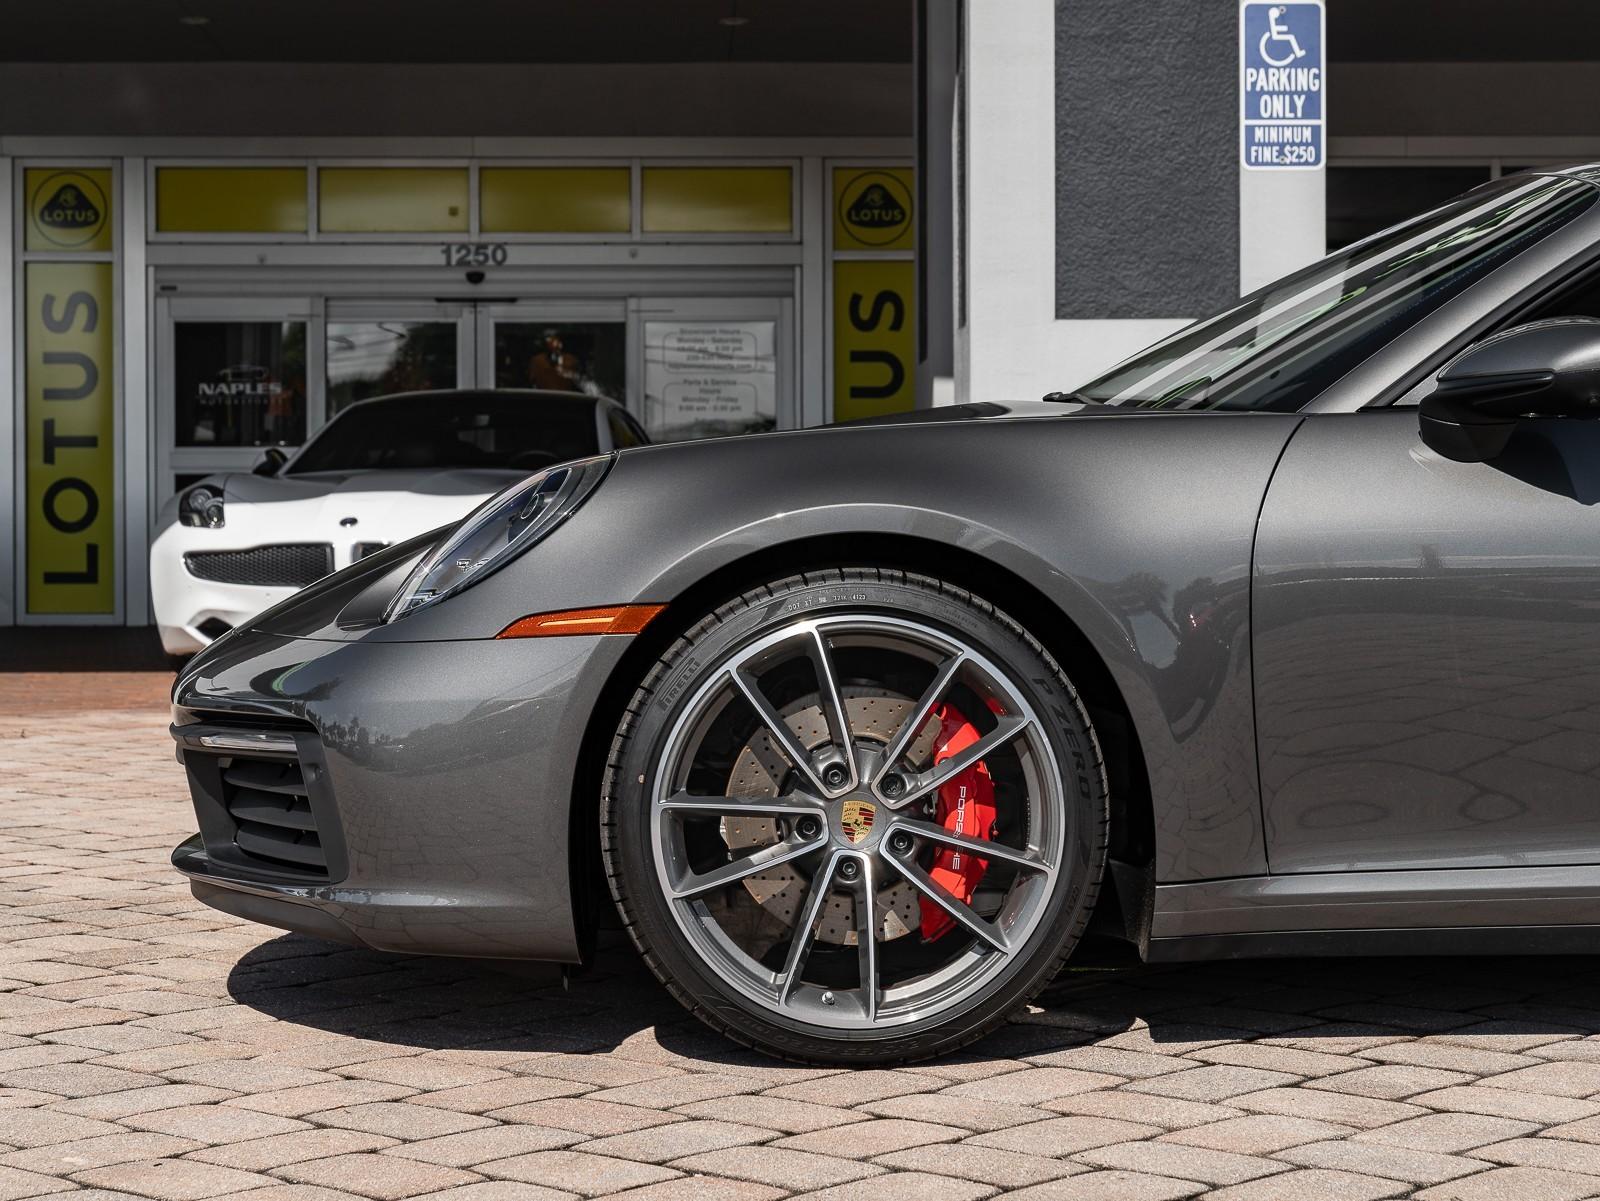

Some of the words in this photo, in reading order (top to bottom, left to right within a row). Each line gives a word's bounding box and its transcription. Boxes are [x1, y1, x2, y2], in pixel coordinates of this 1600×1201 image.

[1246, 67, 1320, 92] PARKING
[1260, 94, 1306, 118] ONLY
[1254, 126, 1312, 143] MINIMUM
[1250, 146, 1280, 163] FINE
[1284, 144, 1316, 164] $250
[44, 209, 95, 221] LOTUS
[851, 208, 902, 221] LOTUS
[441, 244, 508, 266] 1250
[199, 383, 282, 395] NAPLES
[42, 290, 99, 584] LOTUS
[1031, 678, 1054, 696] P
[1051, 704, 1093, 800] ZERO
[952, 786, 967, 870] PORSHE
